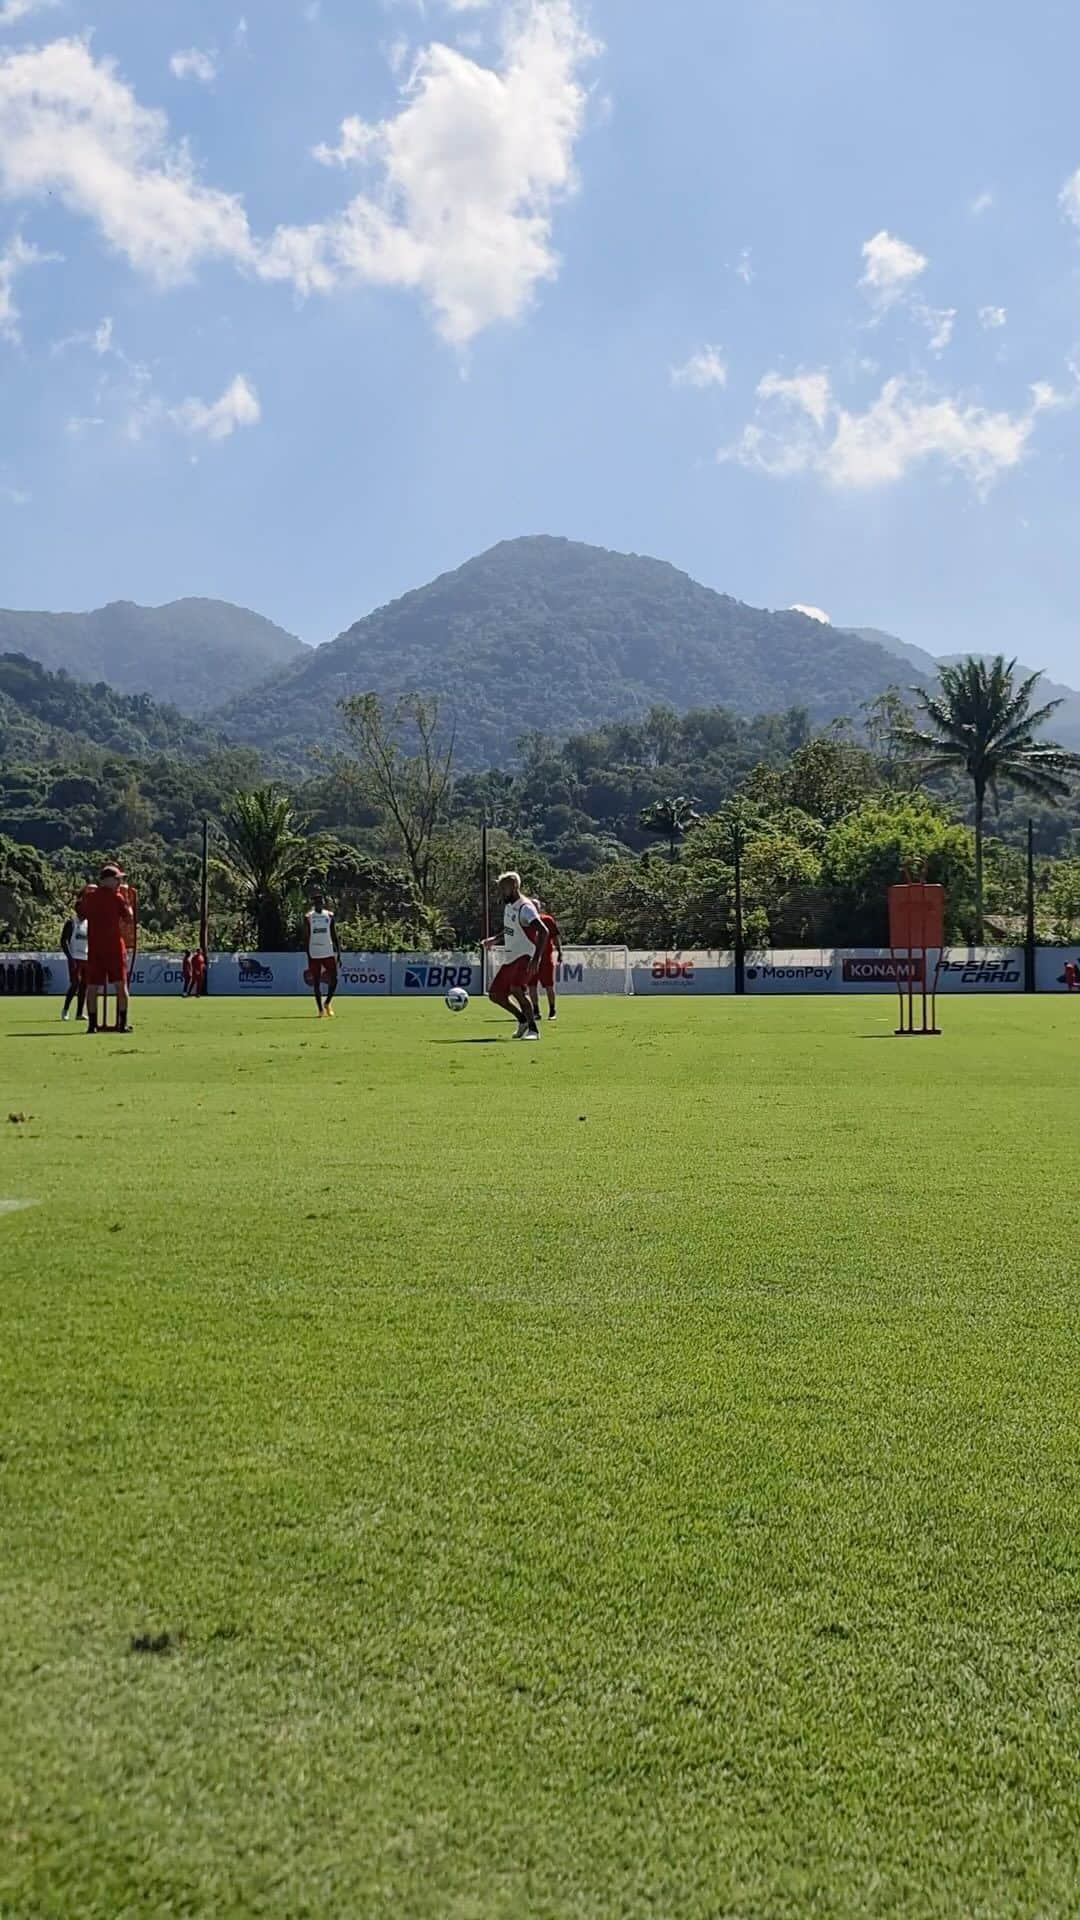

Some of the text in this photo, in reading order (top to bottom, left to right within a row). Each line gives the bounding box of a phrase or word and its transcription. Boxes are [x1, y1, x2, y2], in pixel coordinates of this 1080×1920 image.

[556, 963, 583, 982] IM
[652, 959, 694, 979] abc
[851, 964, 916, 977] KONAMI
[934, 960, 1015, 972] ASSIST
[342, 974, 386, 984] TODOS
[427, 966, 473, 988] BRB
[763, 966, 833, 980] MoonPay
[961, 971, 1020, 983] CARD
